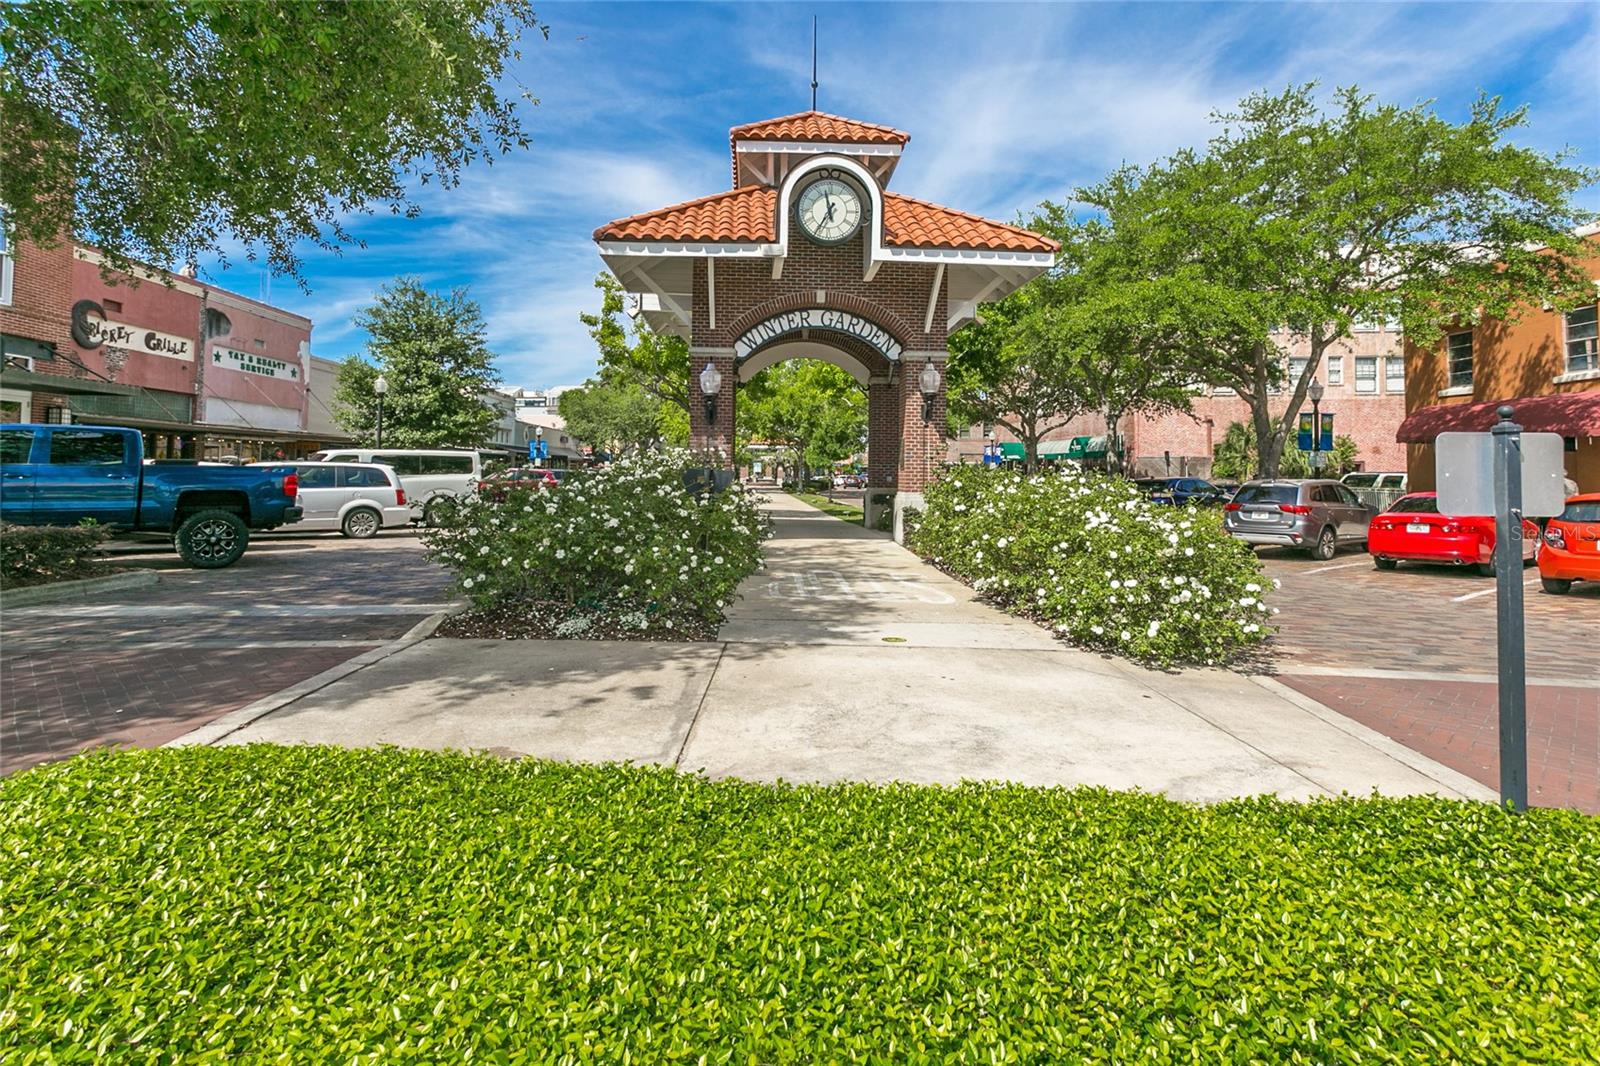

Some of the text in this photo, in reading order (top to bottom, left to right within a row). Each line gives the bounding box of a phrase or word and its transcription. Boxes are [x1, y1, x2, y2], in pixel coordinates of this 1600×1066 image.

[145, 331, 188, 355] GRILLE
[741, 310, 896, 354] WINTER GARDEN
[228, 350, 246, 361] TAX
[256, 357, 287, 370] REALTY
[240, 362, 275, 376] SERVICE
